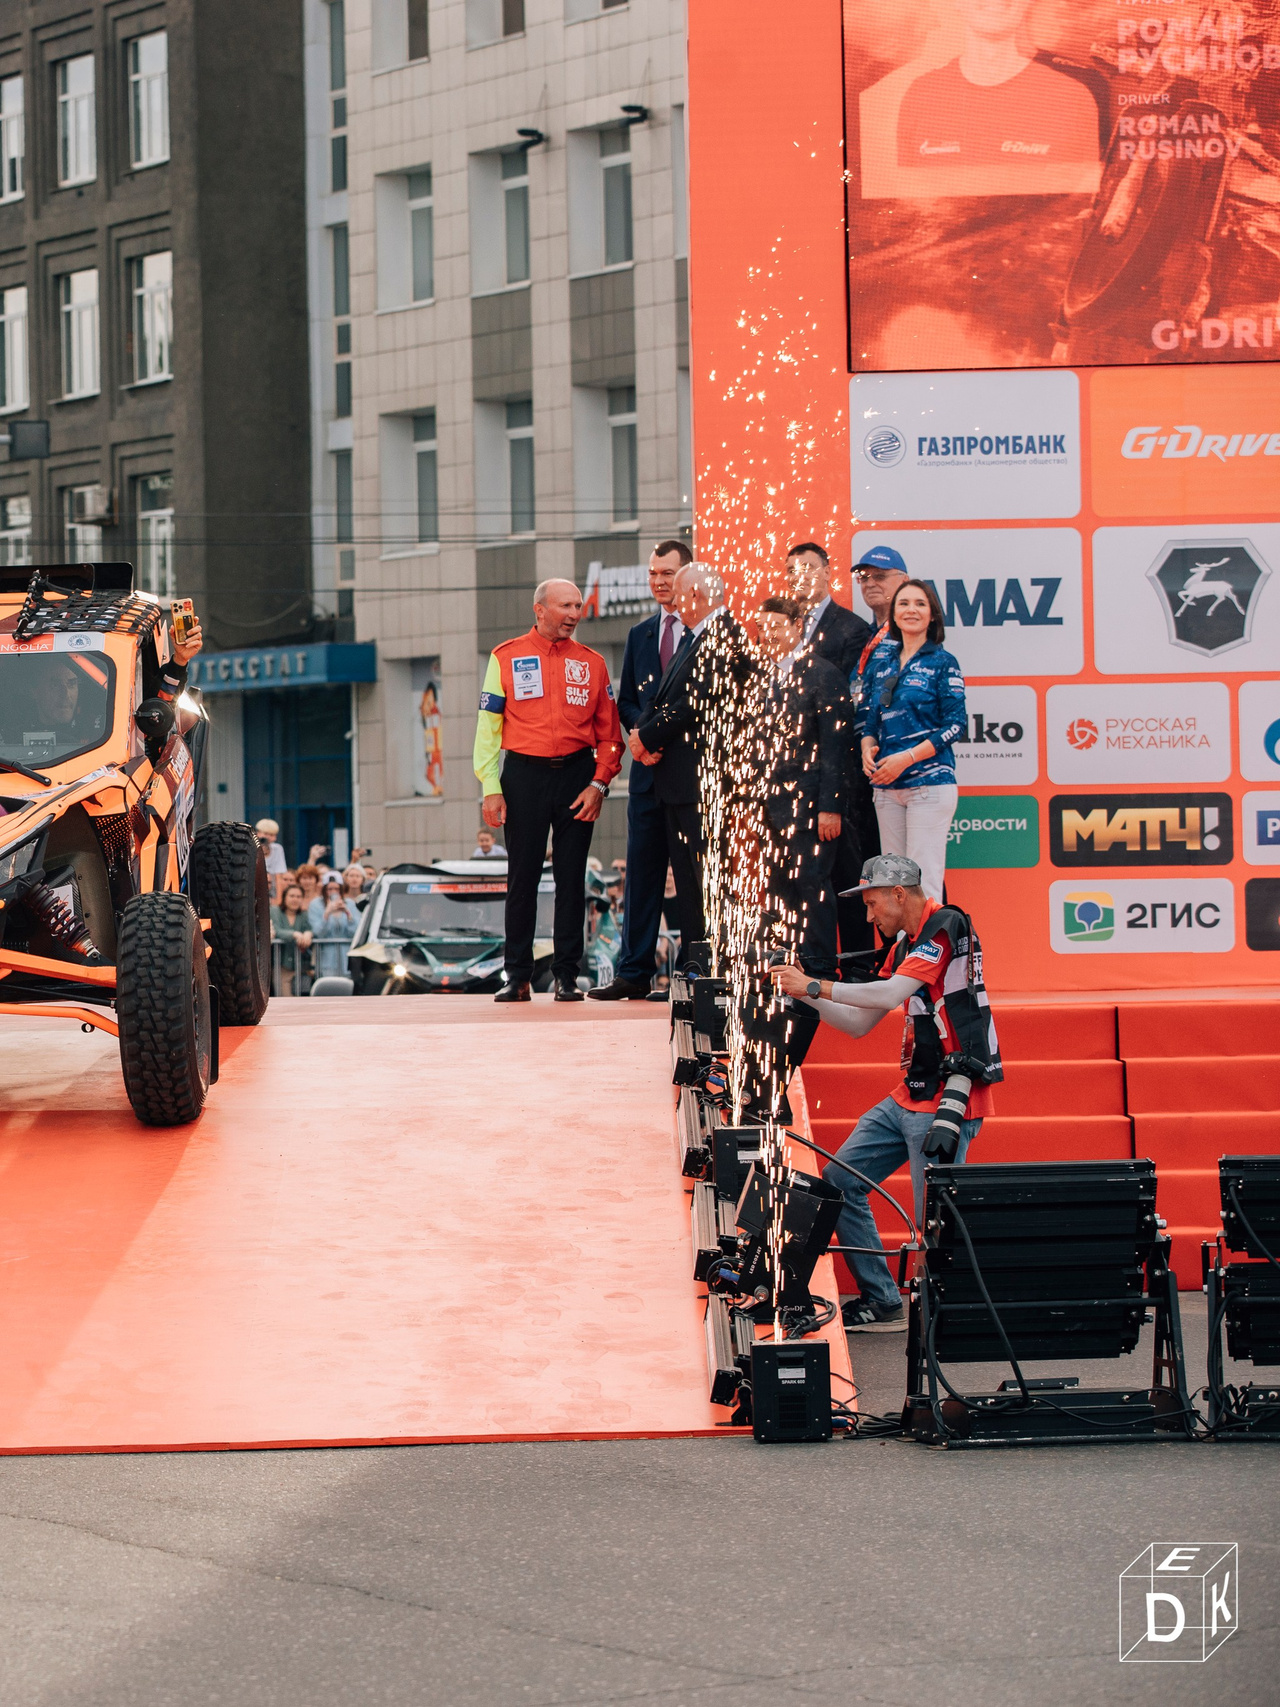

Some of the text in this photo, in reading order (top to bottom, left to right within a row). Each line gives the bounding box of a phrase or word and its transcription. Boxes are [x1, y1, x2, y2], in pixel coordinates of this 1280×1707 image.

[1118, 15, 1244, 43] РОМАН
[1118, 93, 1171, 106] DRIVER
[1119, 114, 1220, 137] ROMAN
[1119, 138, 1243, 161] RUSINOV
[1152, 315, 1280, 350] G-DRI
[918, 434, 1066, 456] ГАЗПРОМБАНК
[566, 686, 589, 697] SILK
[566, 695, 589, 707] WAY
[1105, 718, 1197, 733] РУССКАЯ
[1105, 733, 1211, 750] МЕХАНИКА
[1061, 807, 1221, 852] МАТЧ!
[1126, 902, 1221, 930] 2ГИС
[922, 944, 938, 953] WAY
